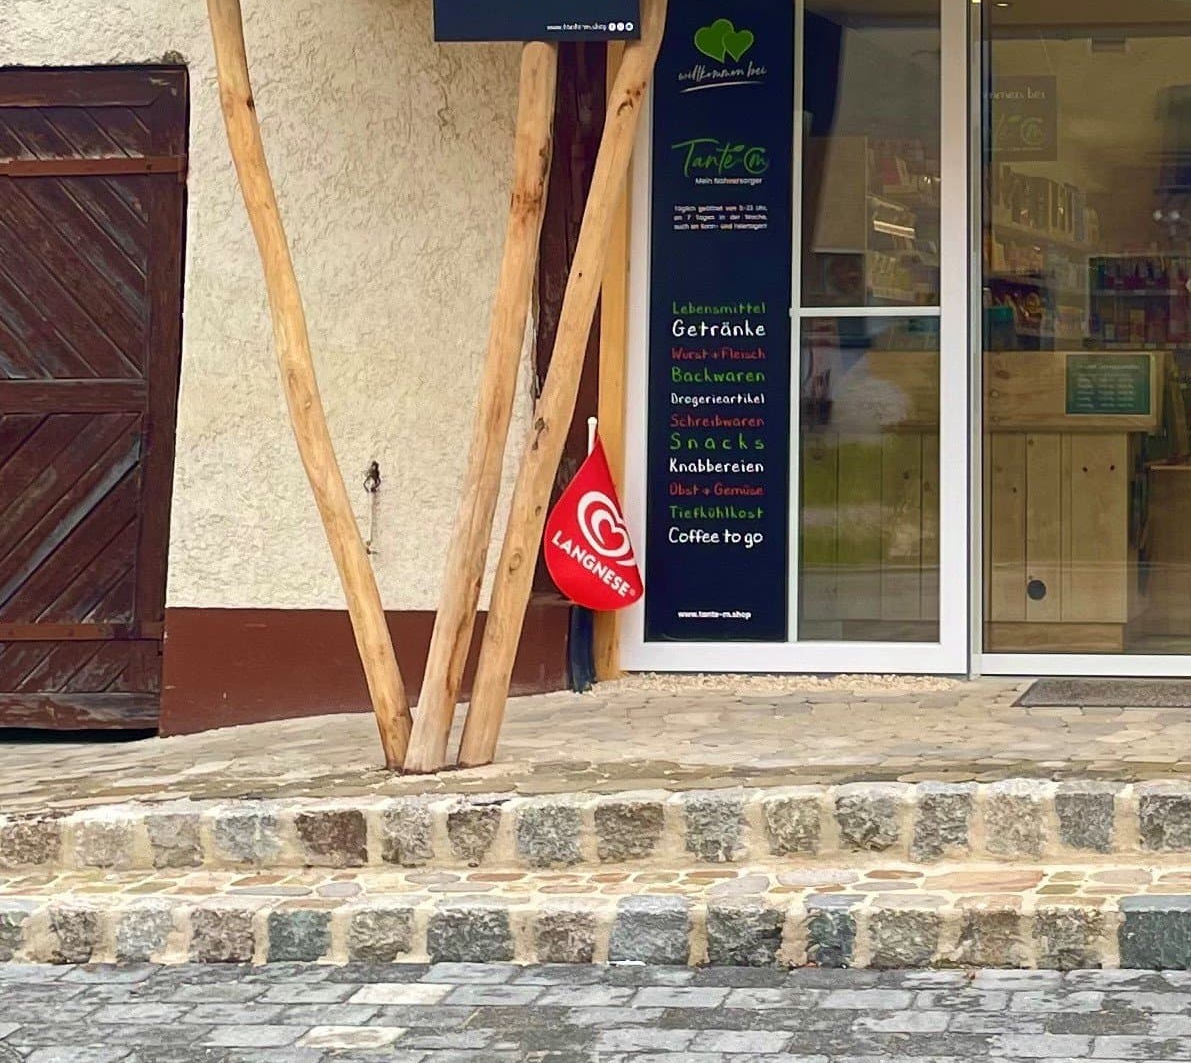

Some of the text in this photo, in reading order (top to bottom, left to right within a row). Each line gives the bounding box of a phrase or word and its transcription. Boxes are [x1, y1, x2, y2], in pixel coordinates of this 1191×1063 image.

[746, 60, 768, 78] bei
[695, 177, 713, 186] Mein
[672, 301, 766, 315] Lebensmittel
[672, 319, 766, 337] Getränke
[671, 347, 707, 360] Wurst
[721, 347, 766, 360] Fleisch
[671, 366, 765, 383] Backwaren
[670, 392, 765, 408] Drogerieartikel
[670, 413, 765, 427] Schreibwaren
[669, 432, 765, 450] Snacks
[669, 457, 765, 473] Knabbereien
[669, 482, 699, 496] Obst
[714, 482, 764, 496] Gemüse
[669, 505, 764, 519] Tiefkühlkost
[668, 526, 764, 549] Coffee to go
[551, 530, 631, 598] LANGNESE
